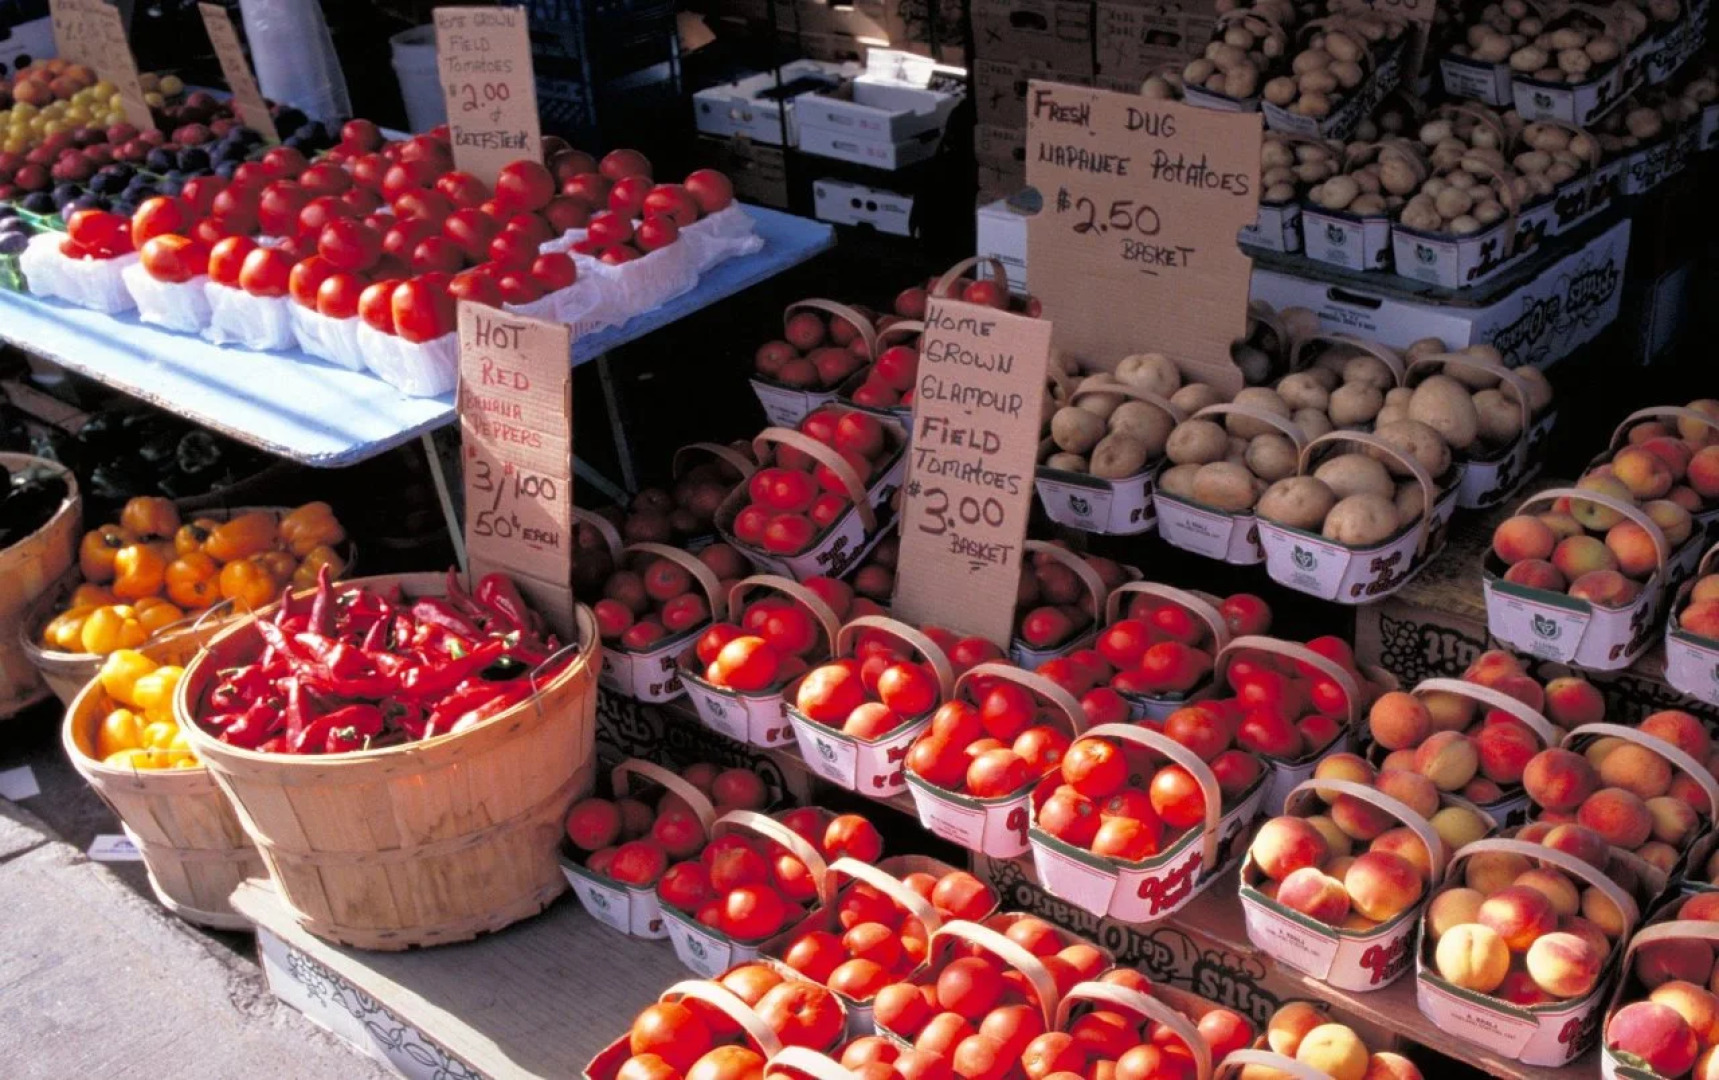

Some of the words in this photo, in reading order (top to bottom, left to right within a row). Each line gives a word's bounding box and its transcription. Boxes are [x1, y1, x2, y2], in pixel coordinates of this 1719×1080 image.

[1033, 89, 1091, 128] FRESH
[1125, 106, 1178, 138] DUG
[1056, 186, 1161, 237] $2.50
[1120, 238, 1196, 268] BASKET
[475, 315, 526, 350] HOT
[924, 305, 996, 338] HOME
[480, 356, 530, 391] RED
[926, 339, 1014, 375] GROWN
[920, 374, 1023, 419] GLAMOUR
[470, 414, 542, 448] PEPPERS
[522, 528, 559, 549] EACH
[948, 532, 1015, 565] BASKET
